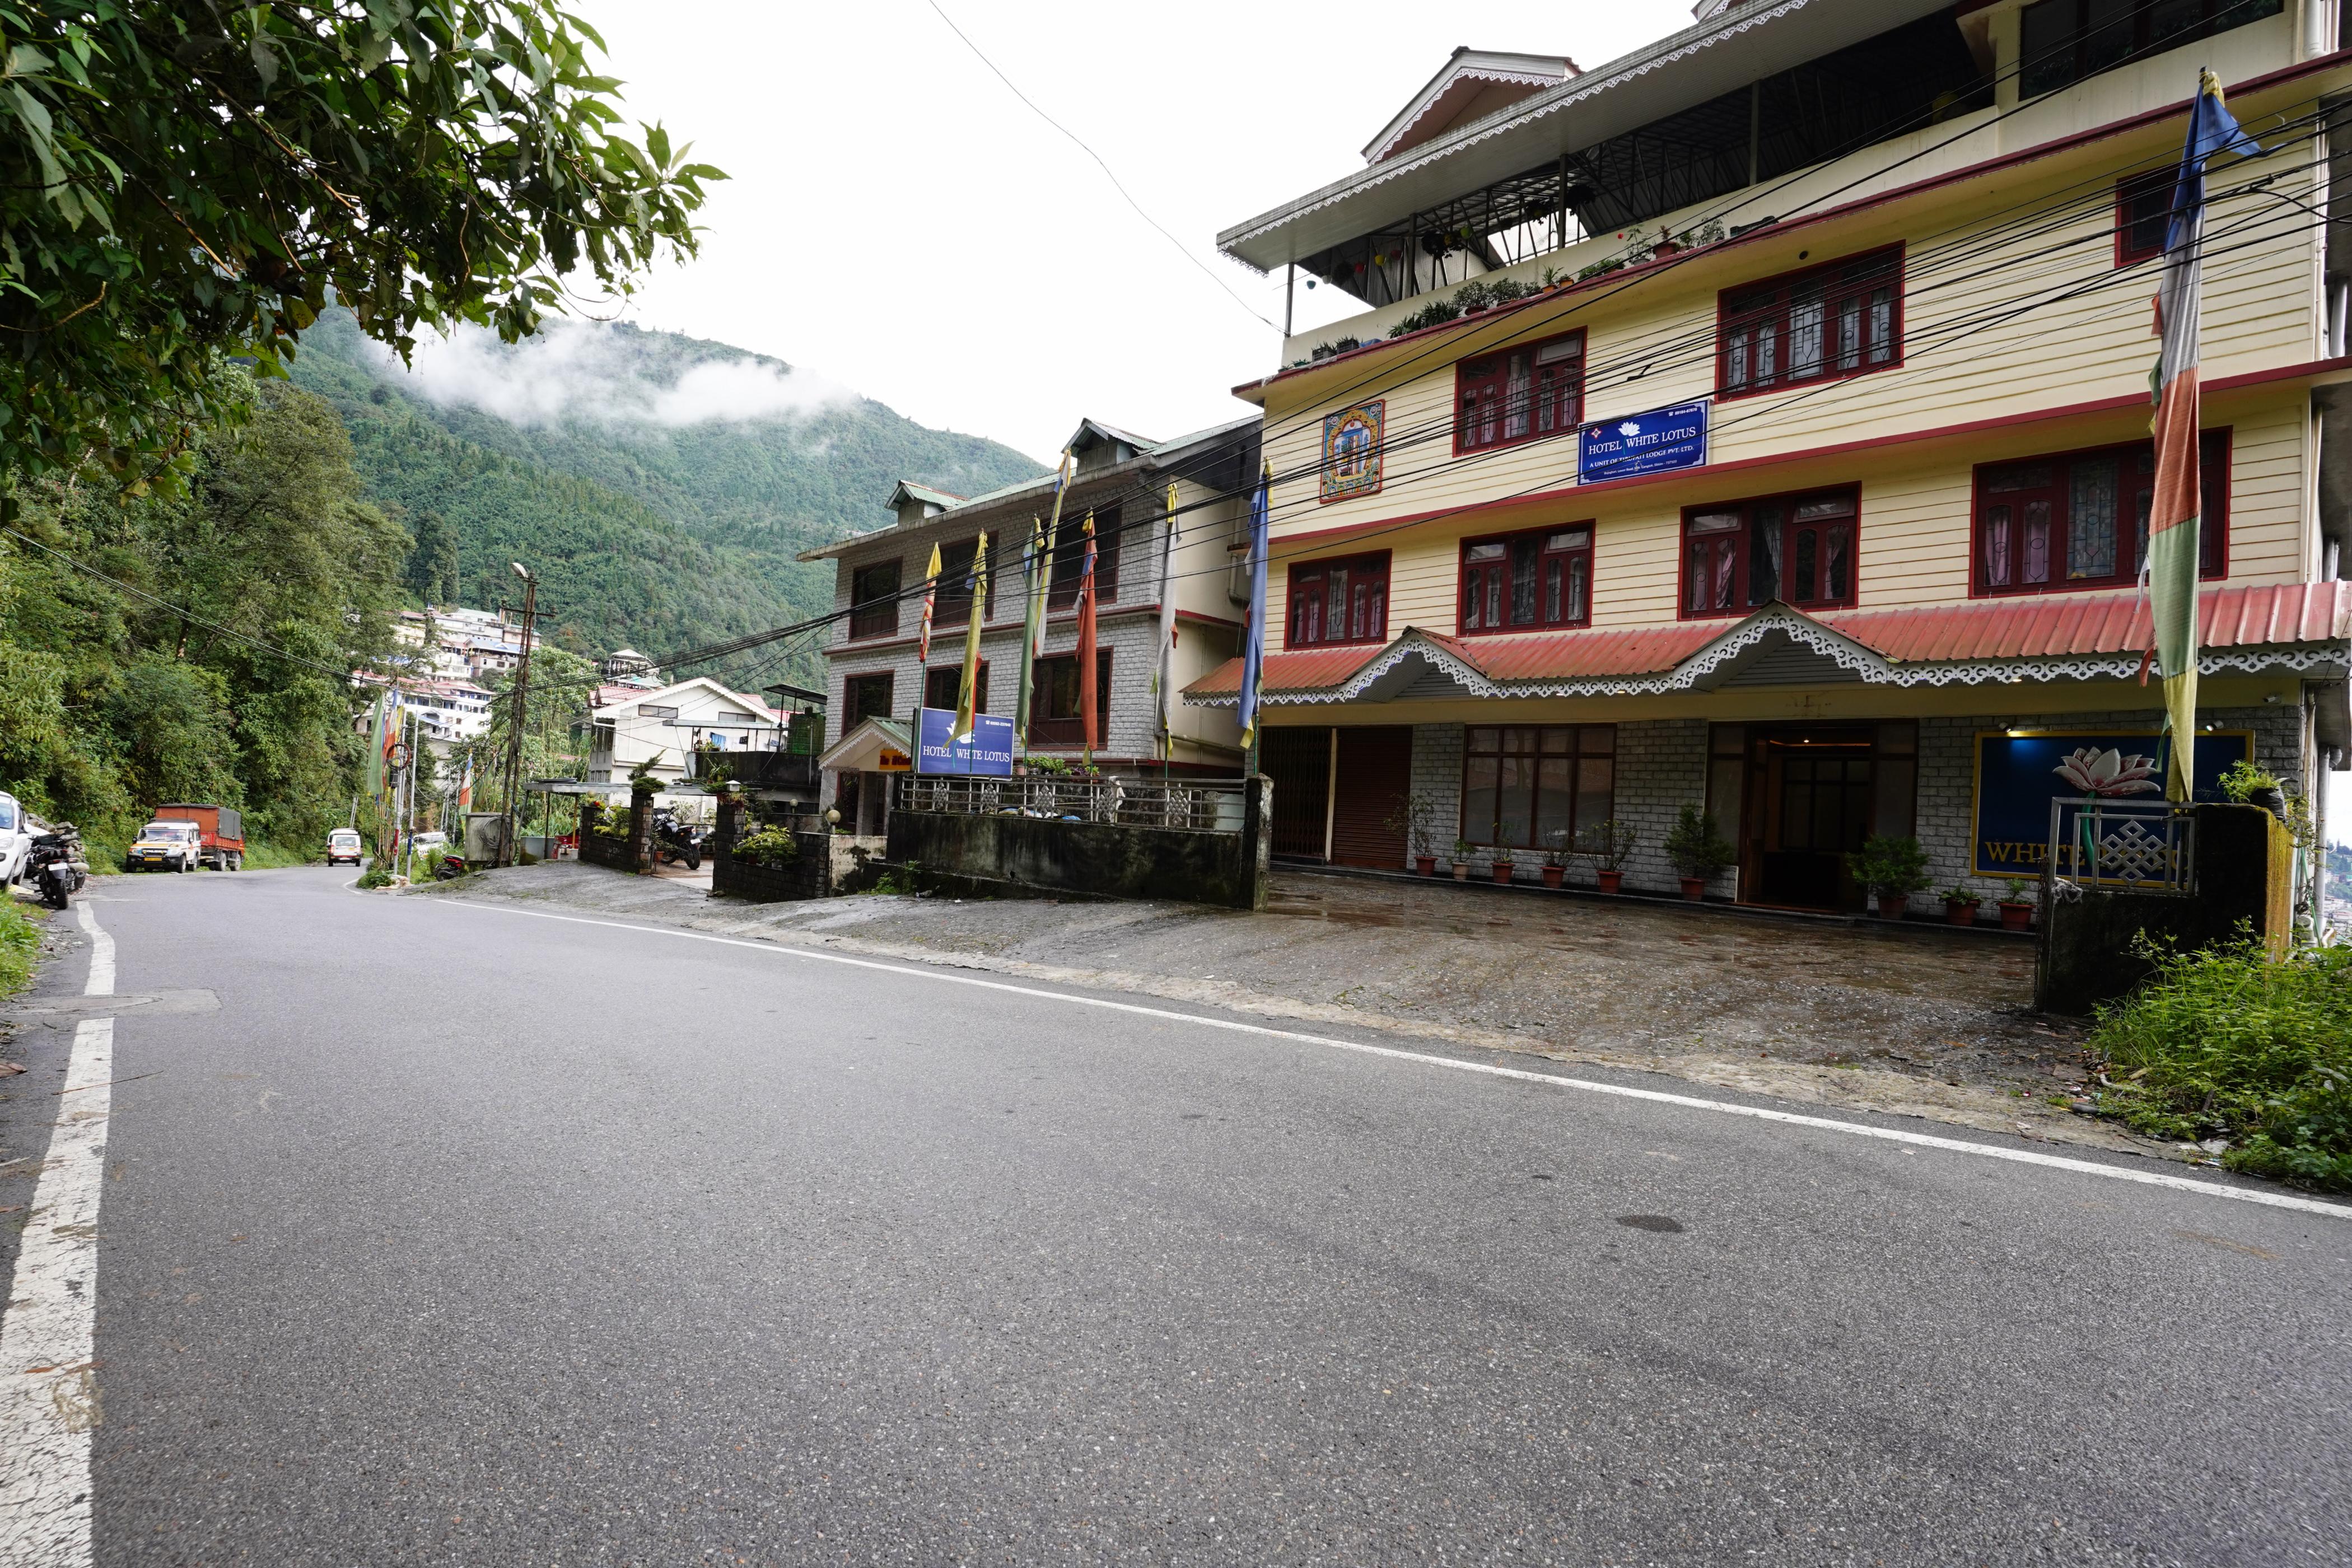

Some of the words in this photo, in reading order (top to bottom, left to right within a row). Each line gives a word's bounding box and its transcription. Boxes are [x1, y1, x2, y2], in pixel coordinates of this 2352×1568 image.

[1588, 440, 1622, 455] HOTEL
[1626, 433, 1659, 448] WHITE
[1662, 426, 1696, 442] LOTUS
[1646, 450, 1667, 458] LODGE
[922, 745, 952, 758] HOTEL
[956, 748, 983, 760] WHTE
[984, 750, 1010, 763] LOTUS
